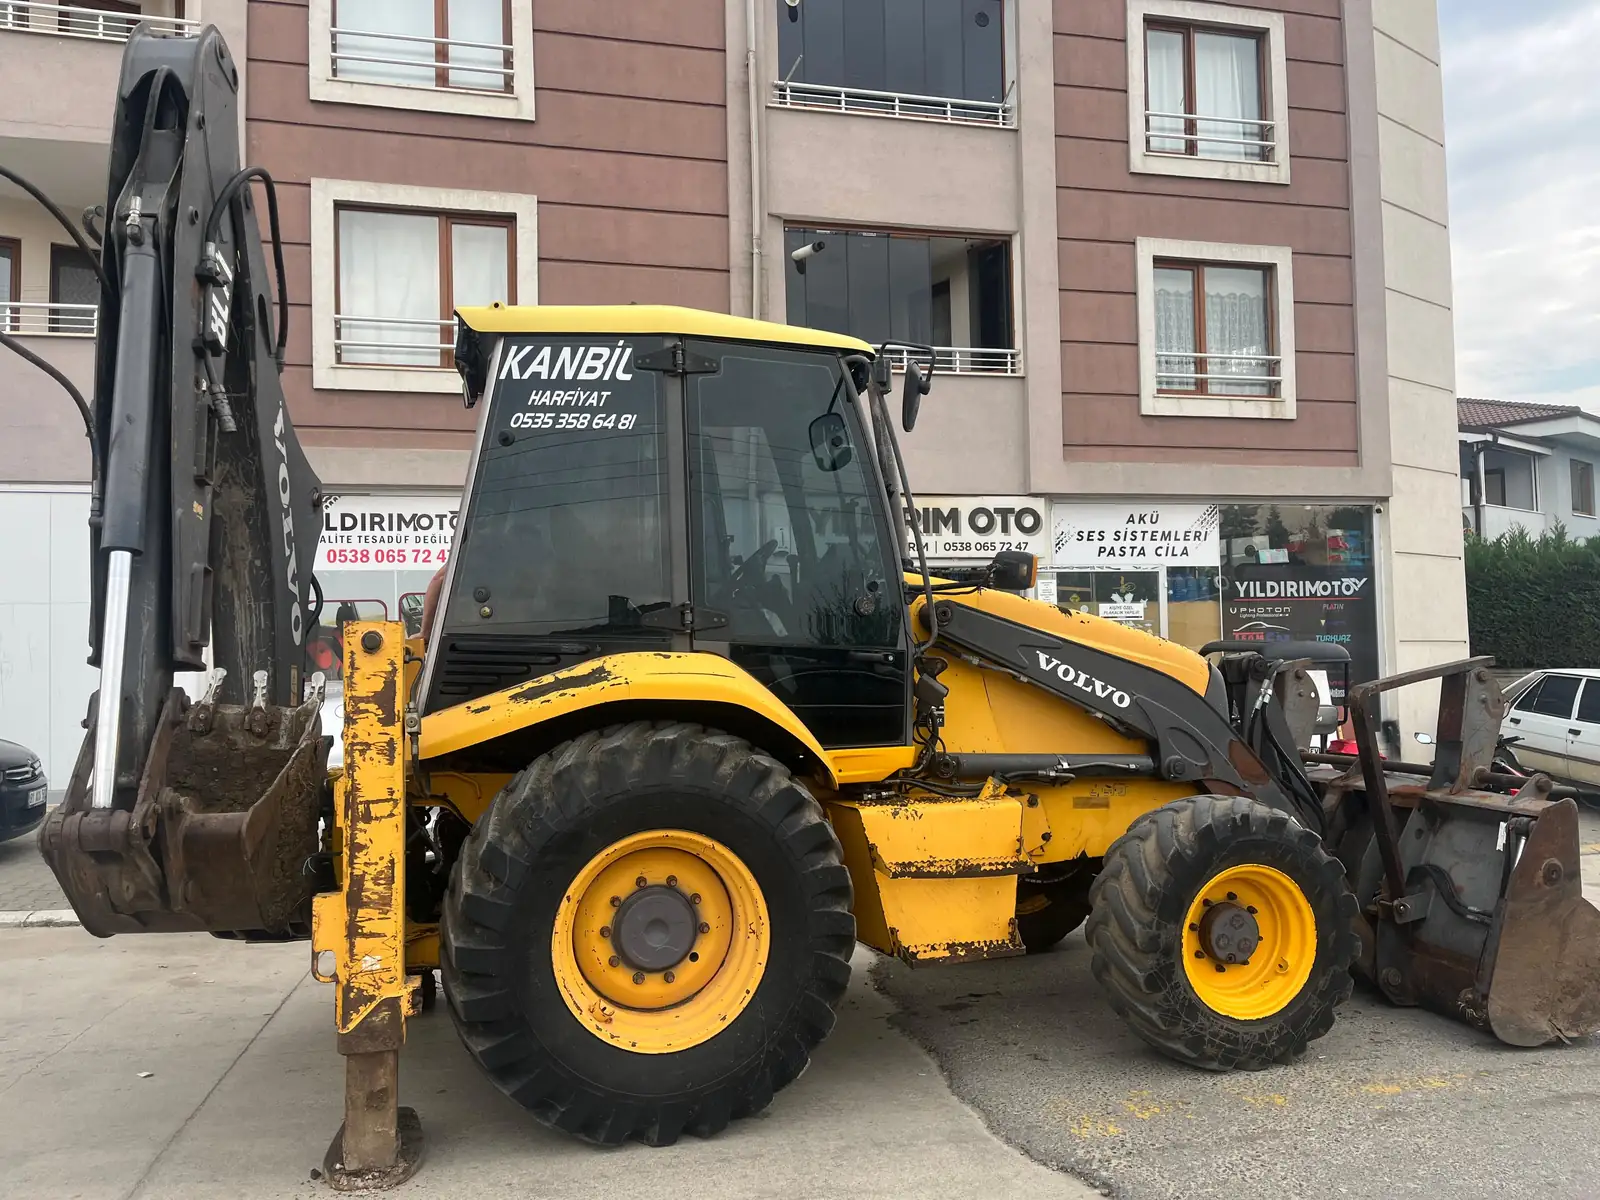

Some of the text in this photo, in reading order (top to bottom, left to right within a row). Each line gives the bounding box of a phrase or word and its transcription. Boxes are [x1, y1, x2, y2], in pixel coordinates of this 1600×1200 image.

[499, 340, 633, 381] KANBİL
[528, 387, 611, 407] HARFİYAT
[510, 413, 637, 430] 0535 358 64 81
[968, 507, 1042, 535] OTO
[1126, 511, 1160, 525] AKÜ
[320, 534, 353, 544] ALİTE
[357, 534, 410, 544] TESADÜF
[1076, 528, 1209, 542] SES SİSTEMLERİ
[943, 542, 972, 552] 0538
[974, 542, 997, 552] 065
[999, 542, 1013, 552] 72
[1015, 542, 1029, 551] 47
[1097, 543, 1190, 557] PASTA CİLA
[326, 549, 451, 564] 0538 065 72 4
[1036, 651, 1131, 708] VOLVO
